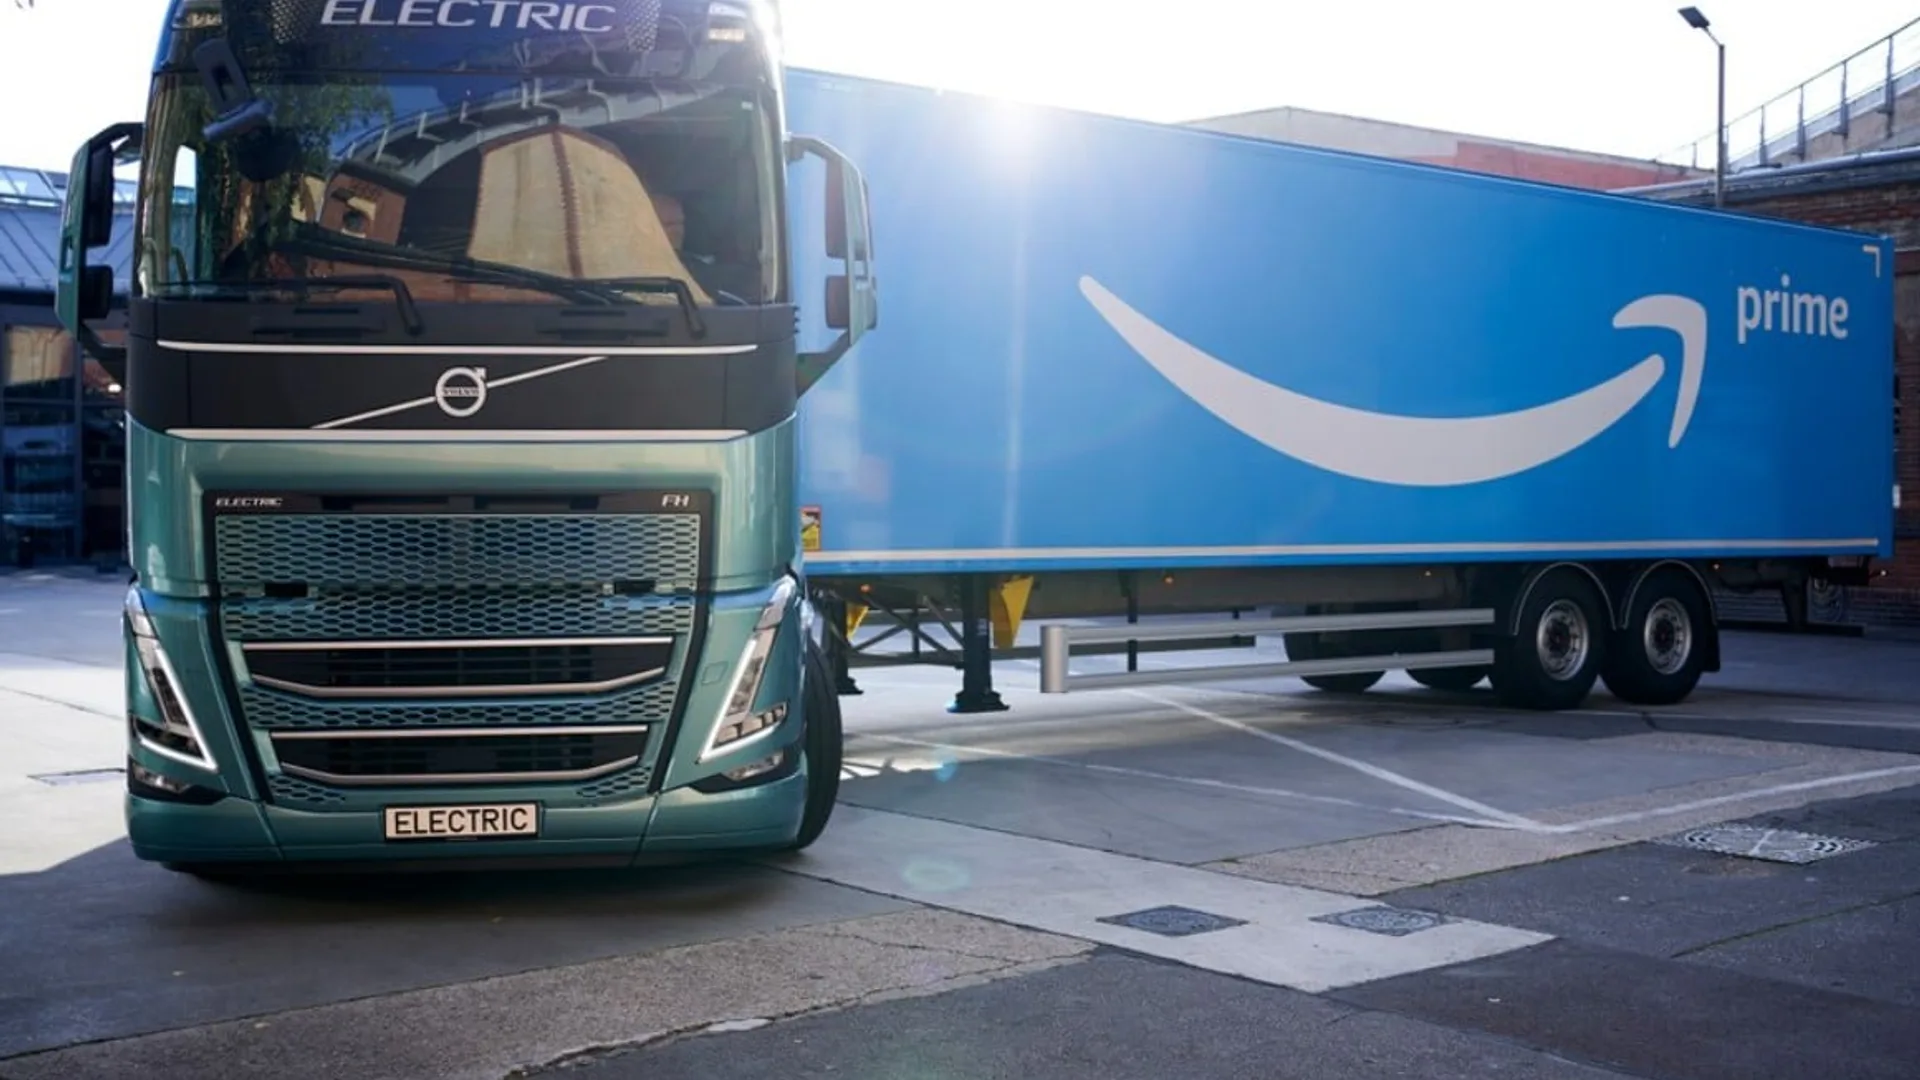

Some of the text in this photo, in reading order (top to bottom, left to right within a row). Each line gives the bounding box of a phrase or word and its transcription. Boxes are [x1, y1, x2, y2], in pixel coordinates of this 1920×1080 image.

[320, 0, 616, 32] ELECTRIC
[1737, 273, 1849, 344] prime
[215, 497, 283, 507] ELECTRIC
[662, 494, 690, 507] FH
[395, 808, 527, 834] ELECTRIC
